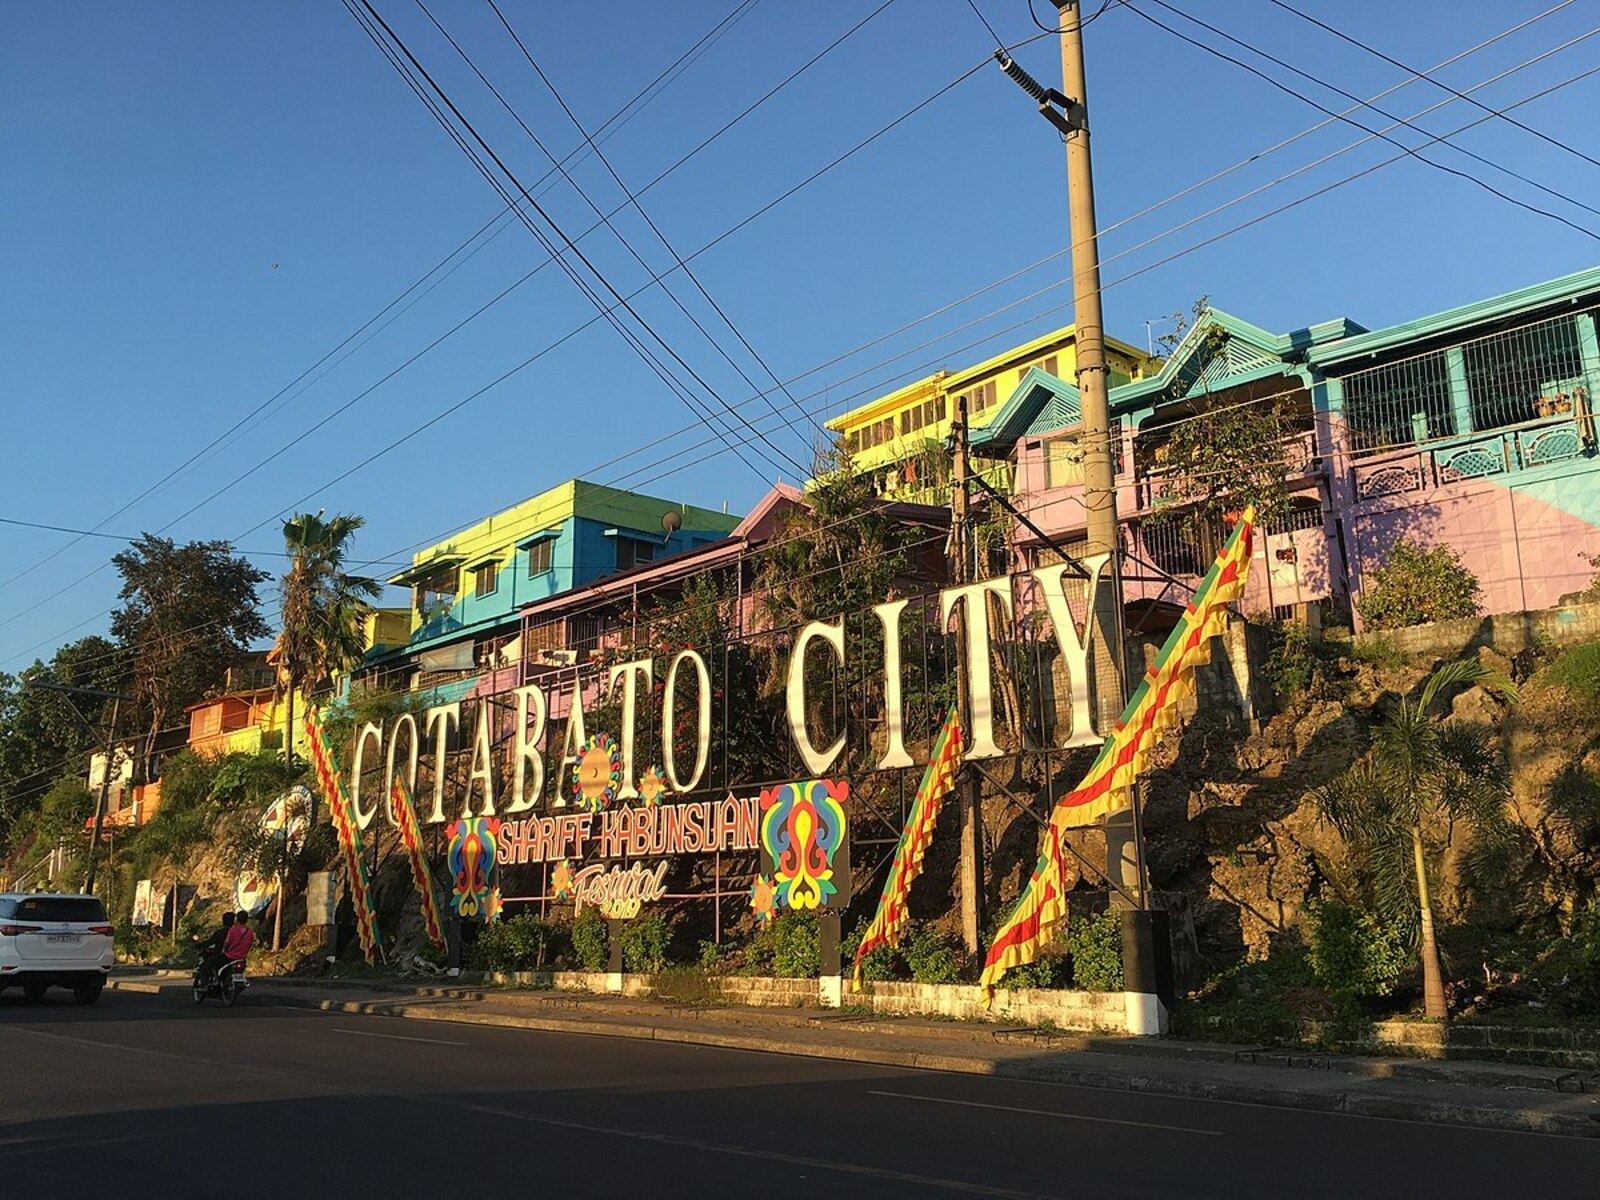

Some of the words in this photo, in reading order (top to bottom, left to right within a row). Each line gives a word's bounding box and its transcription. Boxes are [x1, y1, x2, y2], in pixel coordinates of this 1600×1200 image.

[351, 650, 711, 829] COTABATO
[786, 553, 1111, 774] CITY
[497, 813, 593, 864] SHARIFF
[600, 792, 761, 857] KABUNSUAN
[571, 860, 668, 918] Festival
